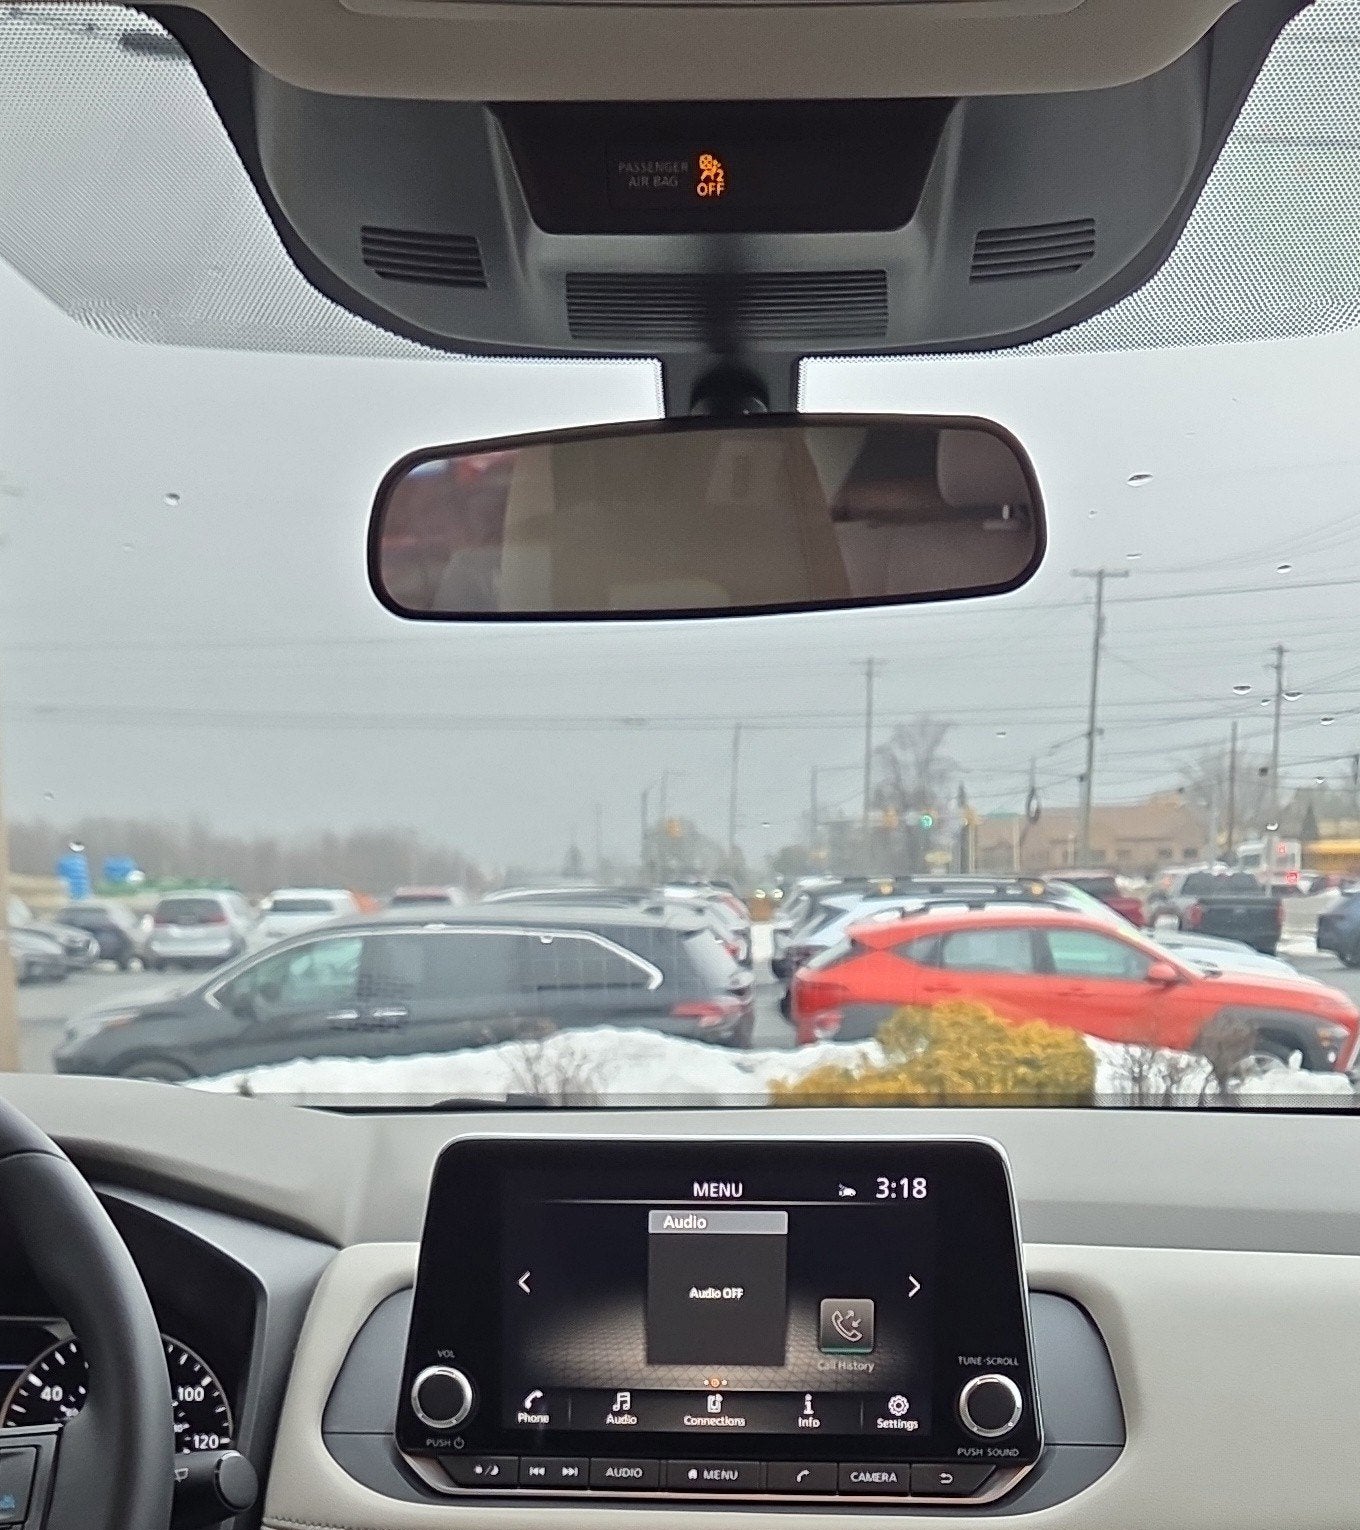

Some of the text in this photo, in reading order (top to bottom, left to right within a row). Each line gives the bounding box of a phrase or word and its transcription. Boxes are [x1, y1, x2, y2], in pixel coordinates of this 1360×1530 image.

[696, 181, 725, 197] OFF
[693, 1182, 743, 1198] MENU
[875, 1177, 928, 1199] 3:18
[663, 1215, 707, 1229] Audio
[689, 1287, 744, 1299] Audio OFF
[838, 1361, 875, 1373] History
[40, 1386, 63, 1401] 40
[177, 1386, 205, 1402] 100
[517, 1412, 550, 1424] Phone
[605, 1414, 638, 1425] Audio
[683, 1415, 746, 1427] Connections
[798, 1417, 821, 1428] Info
[876, 1418, 919, 1431] Settings
[193, 1434, 219, 1450] 120
[426, 1437, 451, 1447] PUSH
[957, 1447, 1020, 1458] PUSH SOUND
[605, 1467, 643, 1478] AUDIO
[703, 1469, 739, 1481] MENU
[850, 1472, 898, 1483] CAMERA
